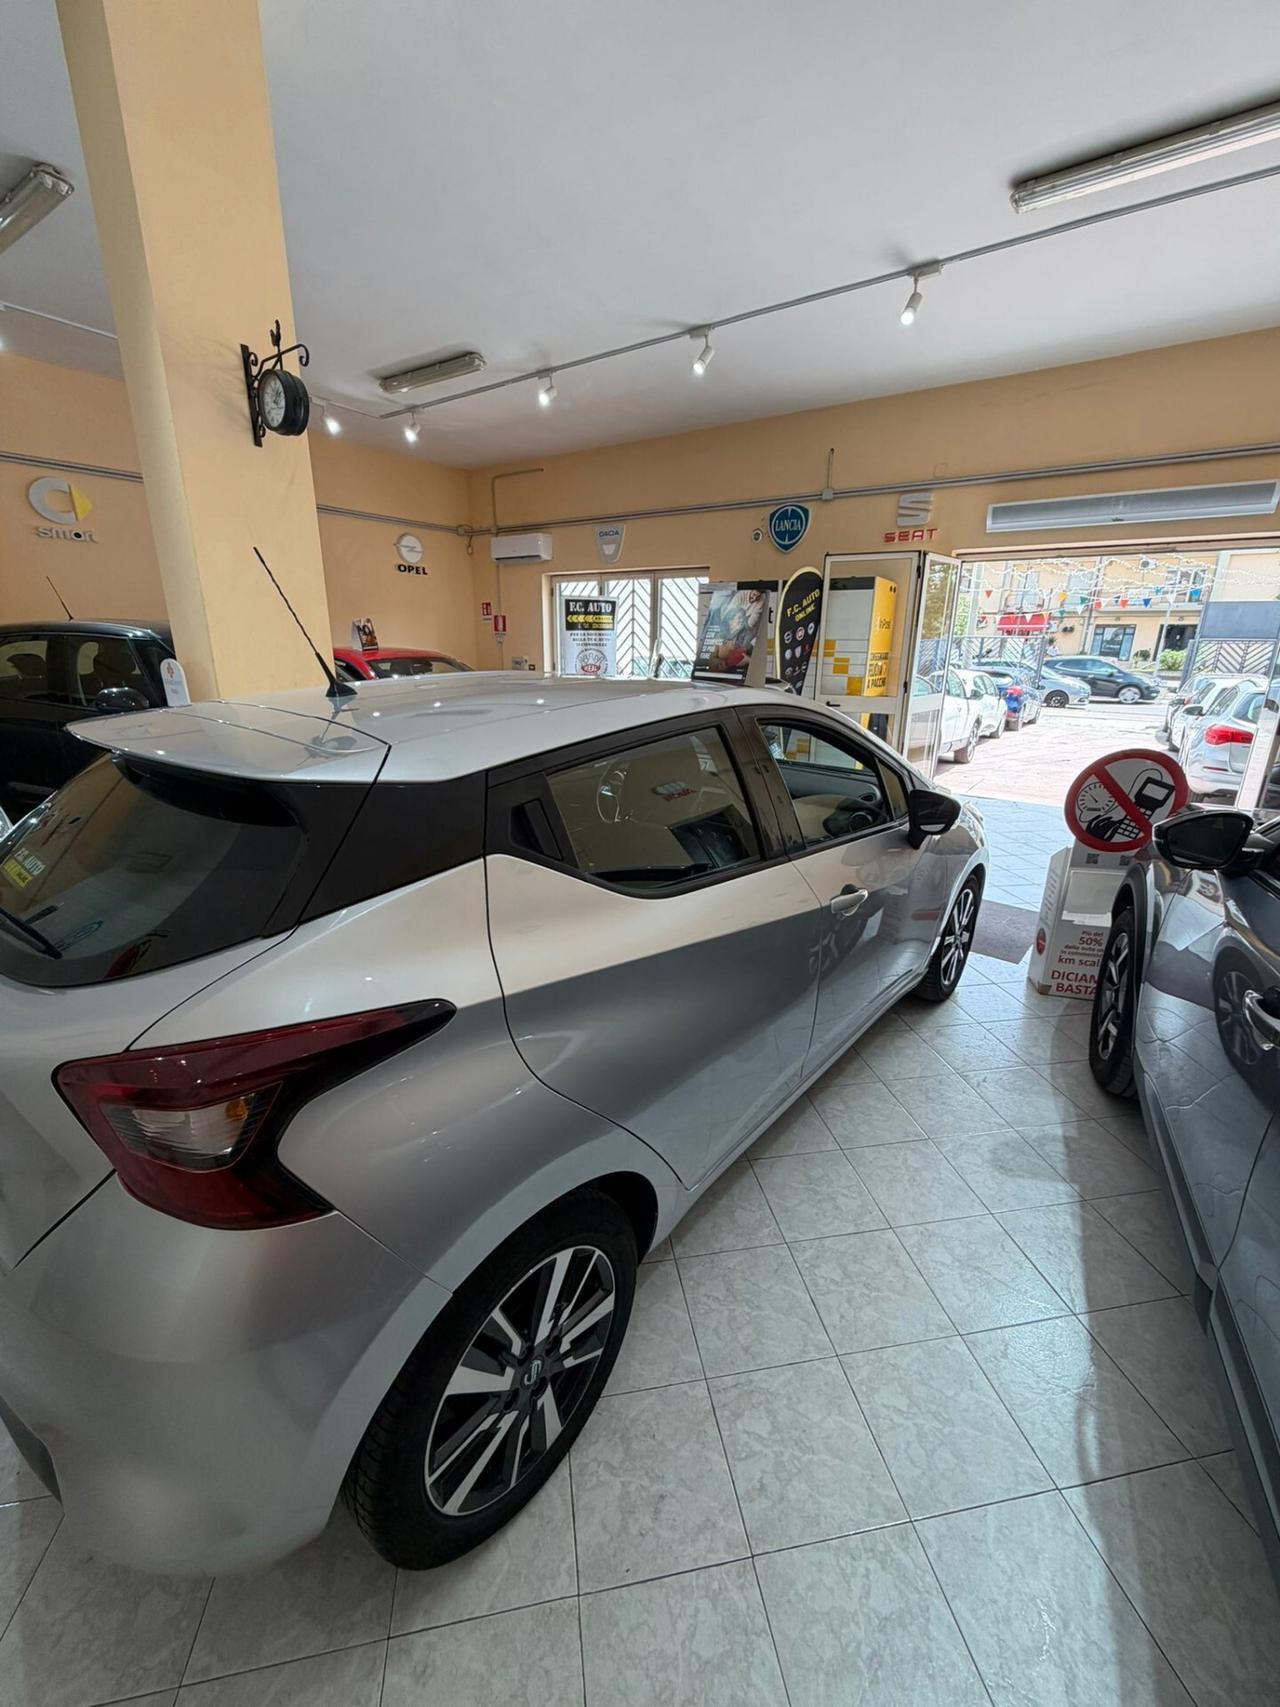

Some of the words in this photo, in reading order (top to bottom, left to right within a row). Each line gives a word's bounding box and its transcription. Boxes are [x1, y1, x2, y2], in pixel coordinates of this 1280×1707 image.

[775, 518, 802, 532] LANCIA
[884, 528, 938, 543] SEAT
[397, 563, 428, 576] OPEL
[802, 588, 820, 607] AUTO
[569, 601, 585, 612] F.C.
[587, 602, 612, 613] AUTO
[794, 602, 816, 622] ONLINE
[1078, 936, 1104, 947] 50%
[1057, 955, 1076, 965] km
[1078, 958, 1100, 967] scal
[1055, 982, 1097, 996] BASTA
